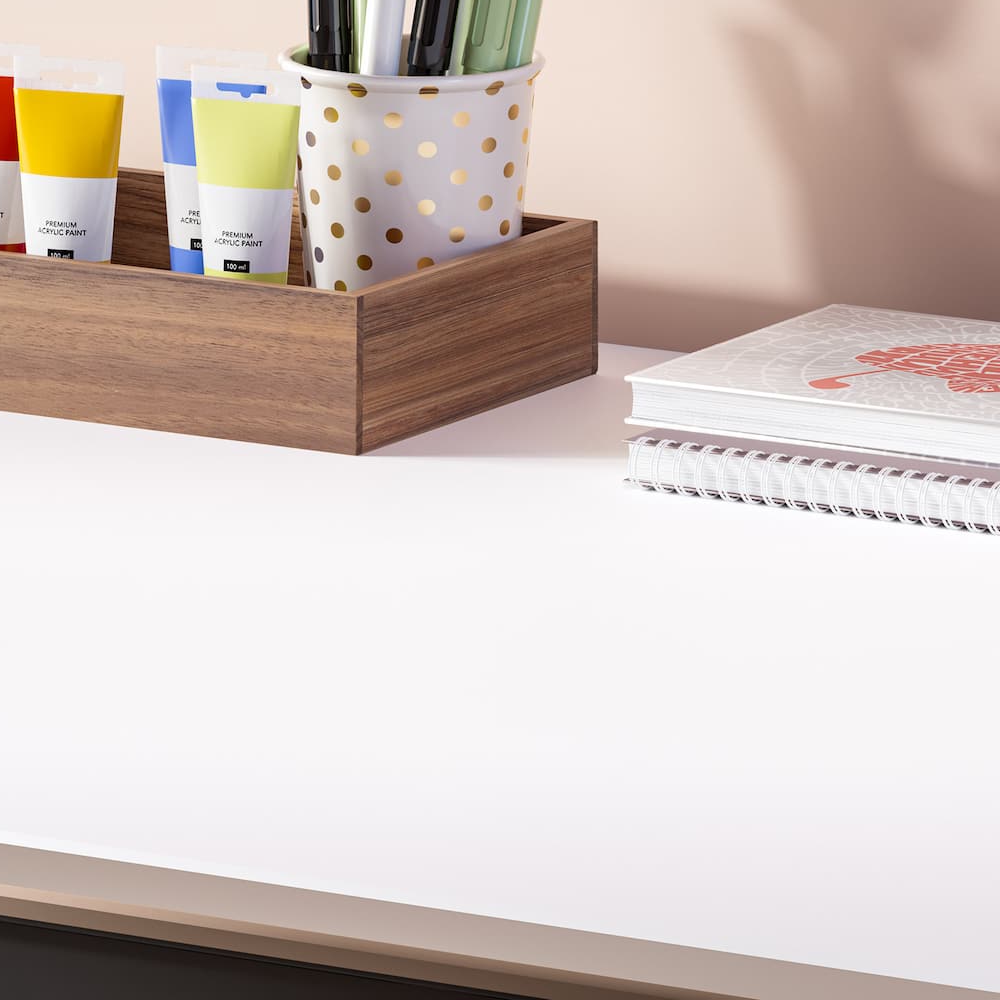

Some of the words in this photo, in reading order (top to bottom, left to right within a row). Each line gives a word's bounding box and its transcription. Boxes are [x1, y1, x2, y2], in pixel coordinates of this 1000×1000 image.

[45, 220, 77, 228] PREMIUM
[180, 217, 201, 225] ACRYL
[37, 226, 64, 235] ACRYLIC
[222, 230, 254, 239] PREMIUM
[214, 238, 240, 246] ACRYLIC
[241, 240, 263, 248] PAINT
[226, 263, 237, 271] 100
